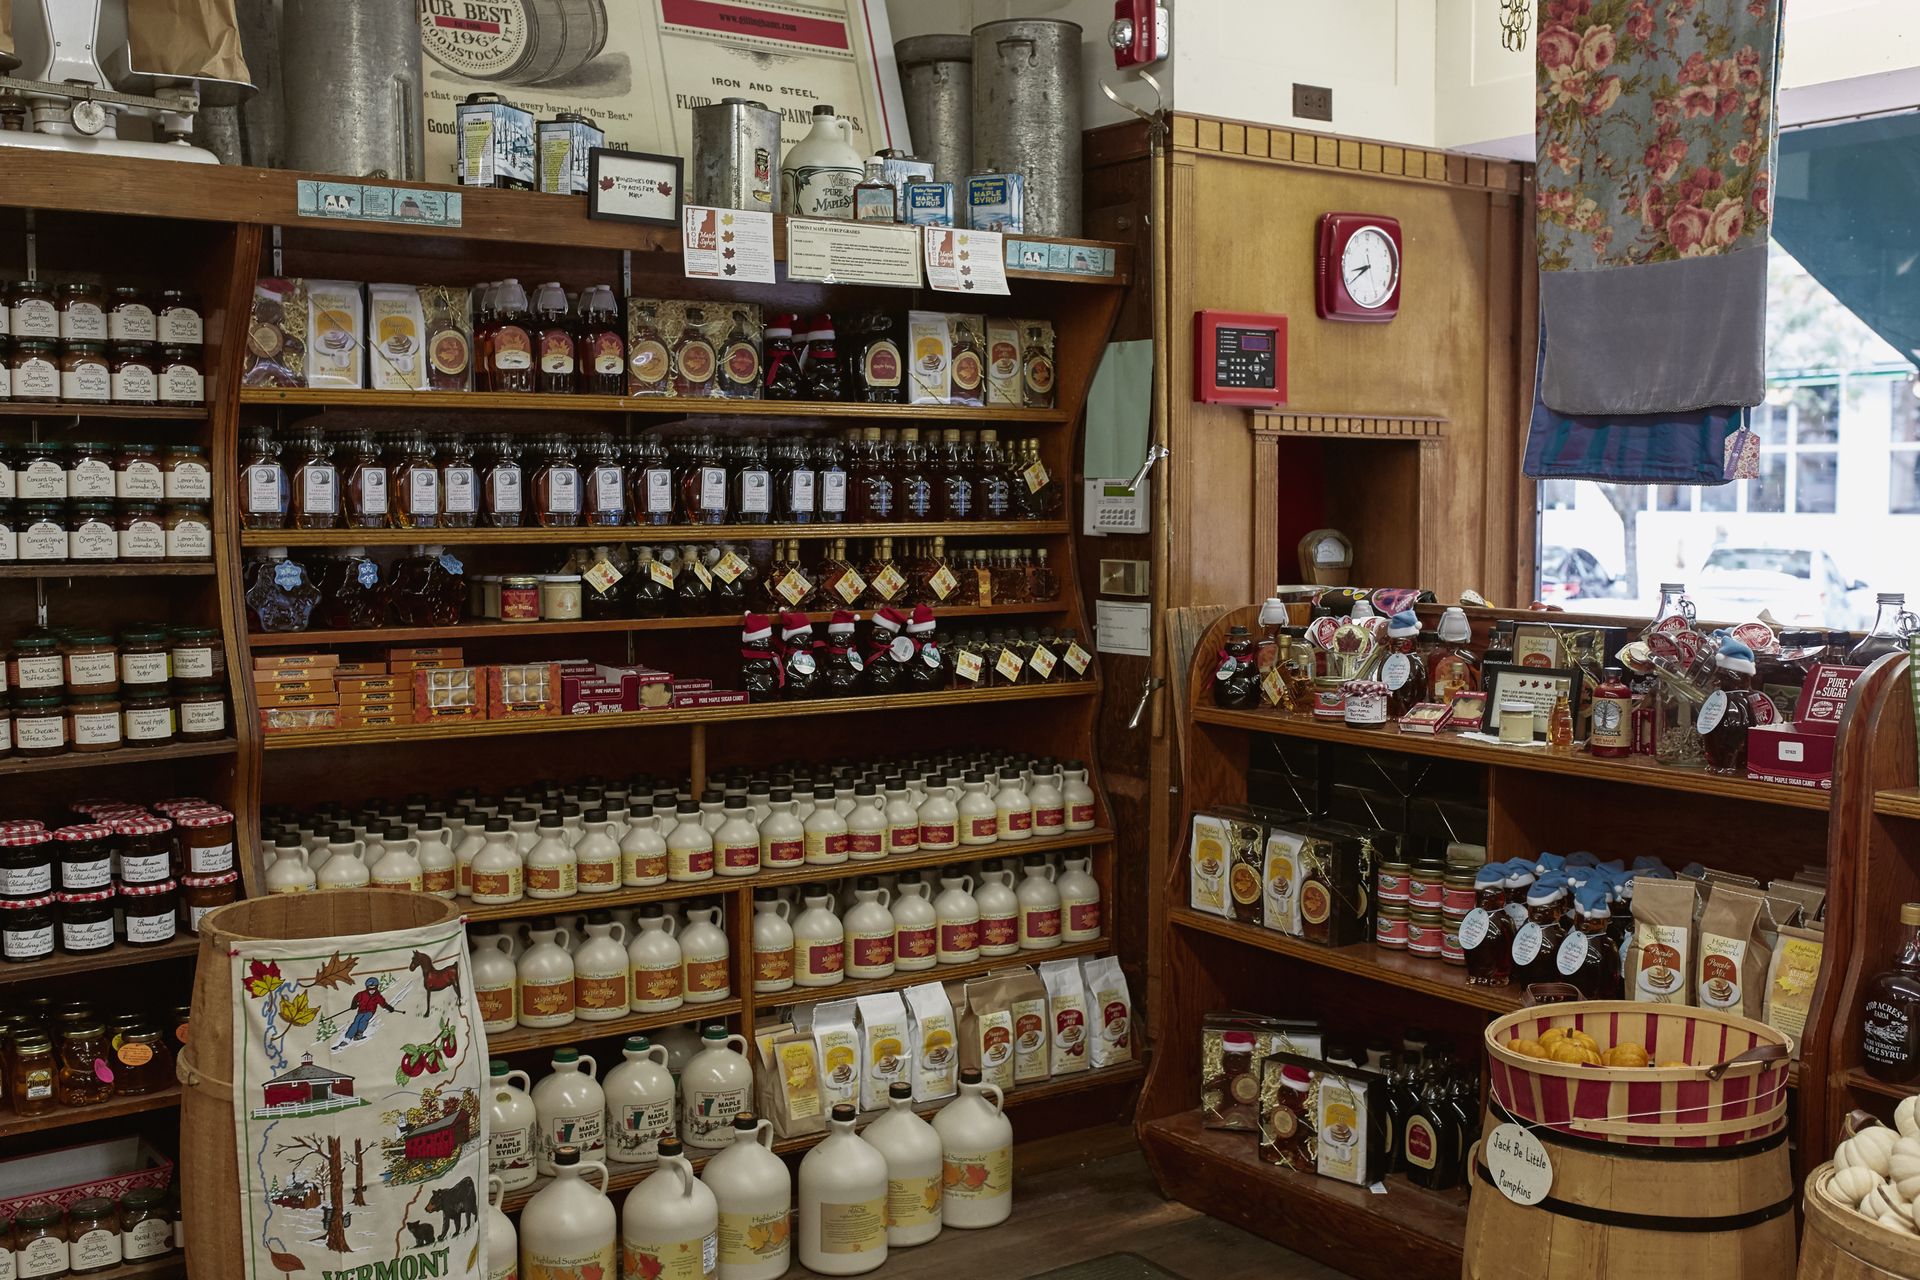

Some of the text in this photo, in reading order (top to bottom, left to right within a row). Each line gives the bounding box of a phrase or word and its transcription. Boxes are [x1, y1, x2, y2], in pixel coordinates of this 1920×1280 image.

[464, 3, 513, 25] BEST
[719, 13, 797, 32] www.gillinghams.com
[1141, 16, 1149, 47] FIRE
[422, 16, 504, 62] WOODSTOCK
[711, 76, 819, 101] IRON AND STEEL,
[429, 89, 451, 101] that
[520, 102, 544, 113] every
[547, 103, 571, 114] barrel
[780, 107, 814, 126] PAINT
[823, 188, 844, 197] PURE
[973, 190, 1001, 198] MAPLE
[812, 196, 843, 212] MAPLE
[973, 197, 1001, 205] SYRUP
[124, 318, 140, 327] Spicy
[171, 321, 187, 331] Spicy
[124, 378, 140, 388] Spicy
[170, 379, 186, 388] Spicy
[37, 482, 54, 492] Jelly
[88, 482, 101, 490] Jam
[37, 543, 54, 552] Jelly
[90, 543, 103, 552] Jam
[504, 603, 534, 614] Maple Butter
[1827, 677, 1848, 688] PURE
[1821, 687, 1848, 699] SUGAR
[1763, 775, 1816, 788] PURE MAPLE SUGAR CANDY
[203, 849, 219, 858] Bonne
[124, 859, 138, 867] Bonne
[68, 925, 83, 934] Bonne
[11, 932, 29, 941] Bonne
[1711, 937, 1738, 950] Highland
[1649, 946, 1674, 958] Pancake
[1706, 943, 1740, 958] Sugarworks
[1653, 956, 1668, 966] Mix
[1707, 958, 1731, 970] Pancake
[1711, 966, 1726, 977] Mix
[1868, 1001, 1901, 1018] TOP ACRES
[1874, 1011, 1889, 1020] FARM
[876, 1025, 897, 1034] Highland
[873, 1031, 900, 1040] Sugarworks
[1864, 1043, 1880, 1055] MAPLE
[1880, 1048, 1908, 1061] SYRUP
[1876, 1041, 1901, 1052] VERMONT
[27, 1079, 50, 1088] Honey
[718, 1099, 741, 1109] MAPLE
[647, 1110, 669, 1121] MAPLE
[718, 1105, 741, 1115] SYRUP
[578, 1121, 600, 1133] MAPLE
[648, 1116, 669, 1127] SYRUP
[579, 1128, 600, 1140] SYRUP
[495, 1140, 521, 1150] MAPLE
[1494, 1131, 1547, 1169] Jack Be Little
[496, 1147, 521, 1157] SYRUP
[950, 1153, 988, 1163] Sugarworks
[1498, 1169, 1532, 1200] Pumpkins
[751, 1212, 778, 1224] Highland
[79, 1249, 113, 1262] Bacon Jam
[532, 1251, 602, 1266] Highland Sugarworks
[26, 1257, 62, 1270] Bacon Jam
